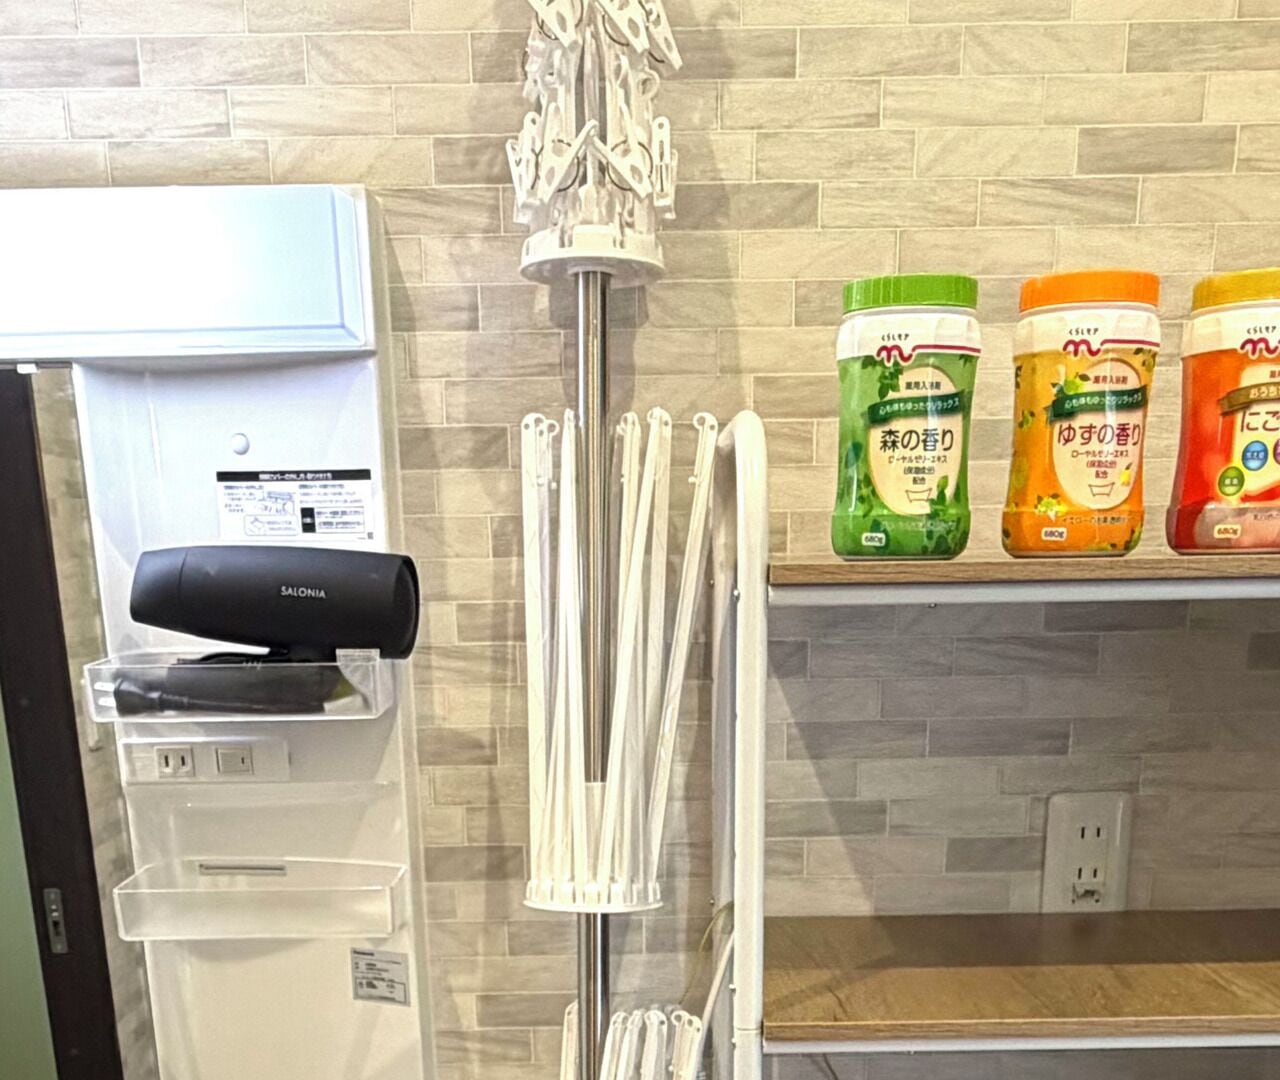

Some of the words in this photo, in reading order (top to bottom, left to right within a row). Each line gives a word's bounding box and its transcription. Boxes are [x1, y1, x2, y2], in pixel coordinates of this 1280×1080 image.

[879, 428, 954, 453] 森の香り
[1057, 422, 1141, 447] ゆずの香り
[1043, 529, 1065, 539] 680g
[1217, 526, 1239, 535] 680g
[864, 534, 884, 545] 680g
[280, 585, 327, 599] SALONIA
